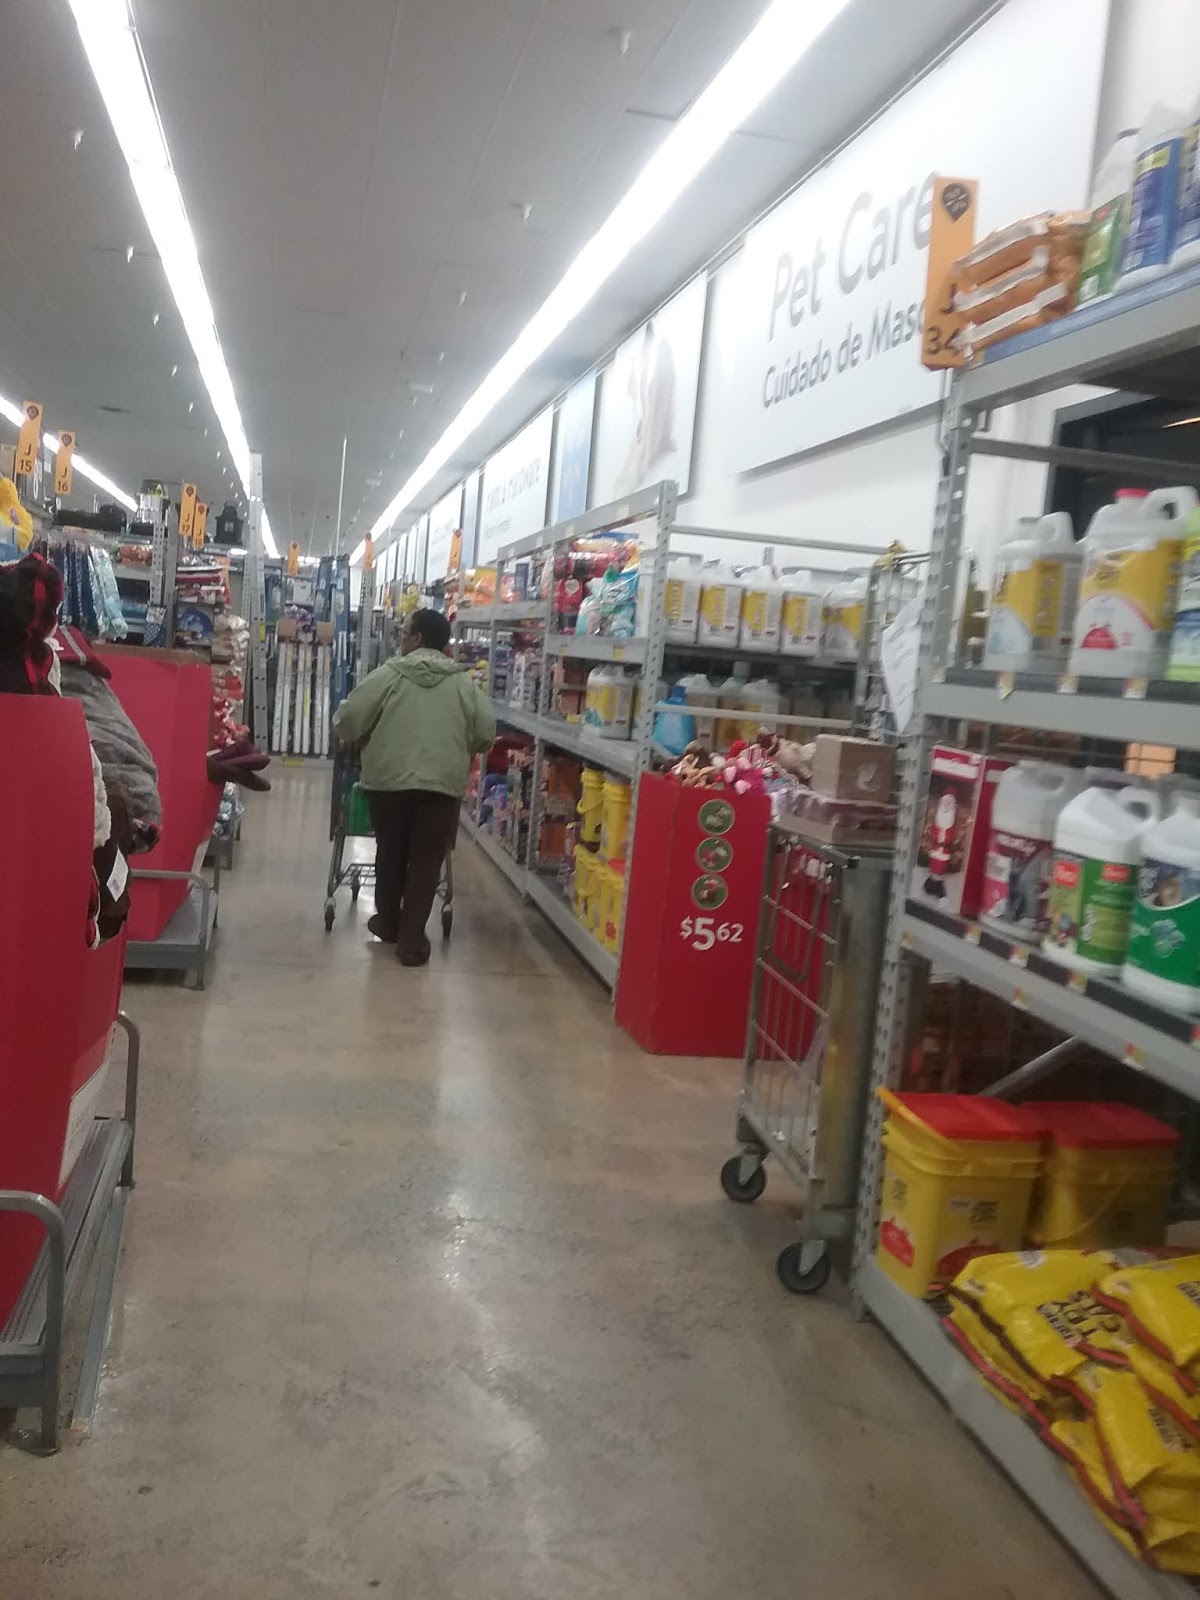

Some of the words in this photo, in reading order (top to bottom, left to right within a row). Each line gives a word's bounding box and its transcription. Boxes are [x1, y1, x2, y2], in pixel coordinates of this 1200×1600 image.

[768, 237, 827, 341] Pet
[838, 170, 938, 295] Care
[763, 338, 832, 408] Cuidado
[837, 321, 862, 374] de
[24, 443, 32, 456] J
[20, 460, 32, 472] 15
[61, 467, 68, 478] J
[57, 480, 69, 492] 16
[185, 513, 190, 522] J
[182, 524, 191, 533] 17
